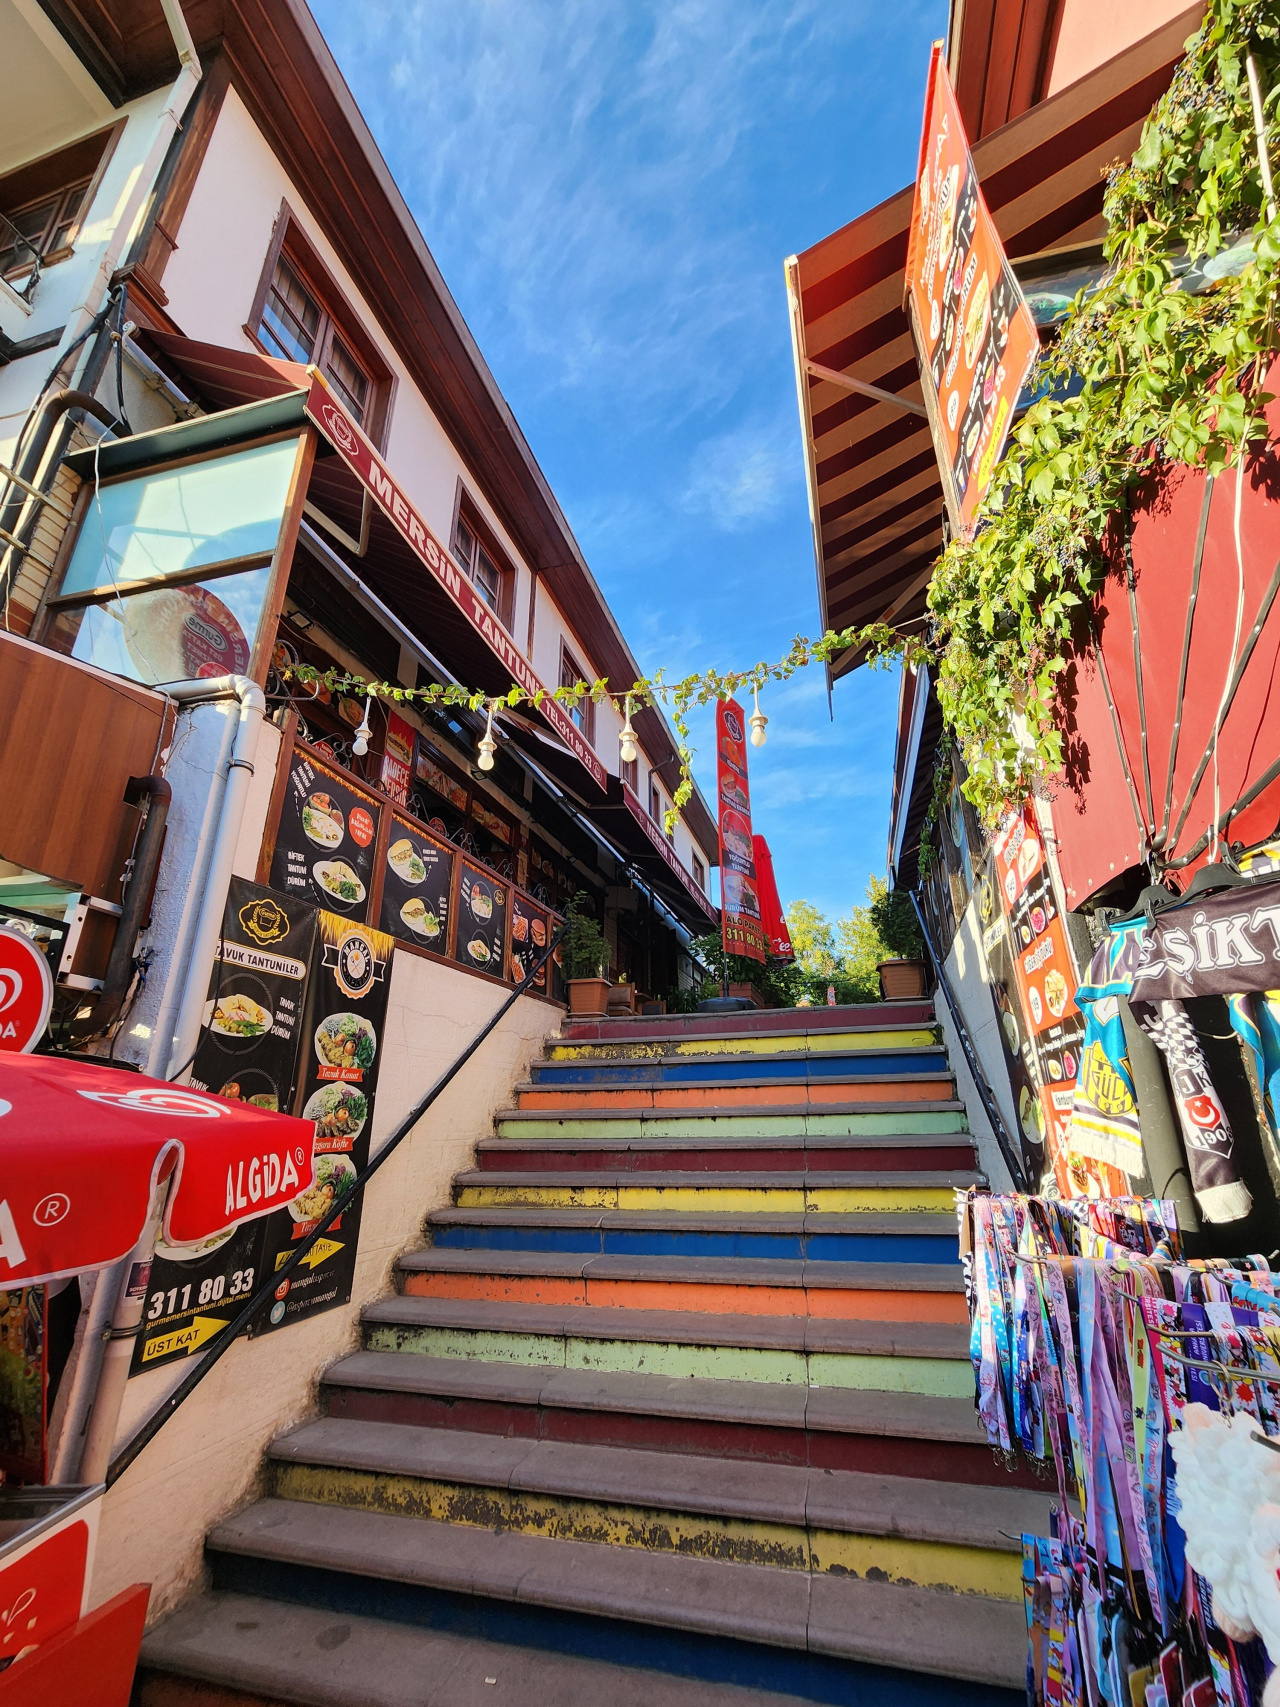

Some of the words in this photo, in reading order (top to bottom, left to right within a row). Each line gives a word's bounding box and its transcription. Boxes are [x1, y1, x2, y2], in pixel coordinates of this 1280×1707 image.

[575, 742, 584, 758] 80
[584, 753, 593, 769] 33
[382, 755, 410, 787] SADECE
[290, 770, 307, 798] YOĞURTLU
[287, 851, 305, 862] BİFTEK
[726, 914, 743, 926] ALO
[744, 919, 761, 934] PAKET
[726, 927, 744, 942] 311
[747, 932, 755, 946] 80
[756, 937, 763, 951] 33
[343, 941, 370, 960] MANGAL
[247, 953, 299, 976] TANTUNİLER
[280, 996, 295, 1010] TAVUK
[275, 1010, 295, 1027] TANTUNİ
[271, 1025, 291, 1040] DÜRÜM
[321, 1067, 340, 1080] Tavuk
[340, 1068, 360, 1081] Kanat
[189, 1077, 209, 1092] TAVUK
[332, 1138, 349, 1149] Köfte
[147, 1284, 192, 1320] 311
[198, 1275, 226, 1305] 80
[229, 1267, 255, 1295] 33
[146, 1338, 173, 1357] ÜST
[175, 1328, 201, 1350] KAT
